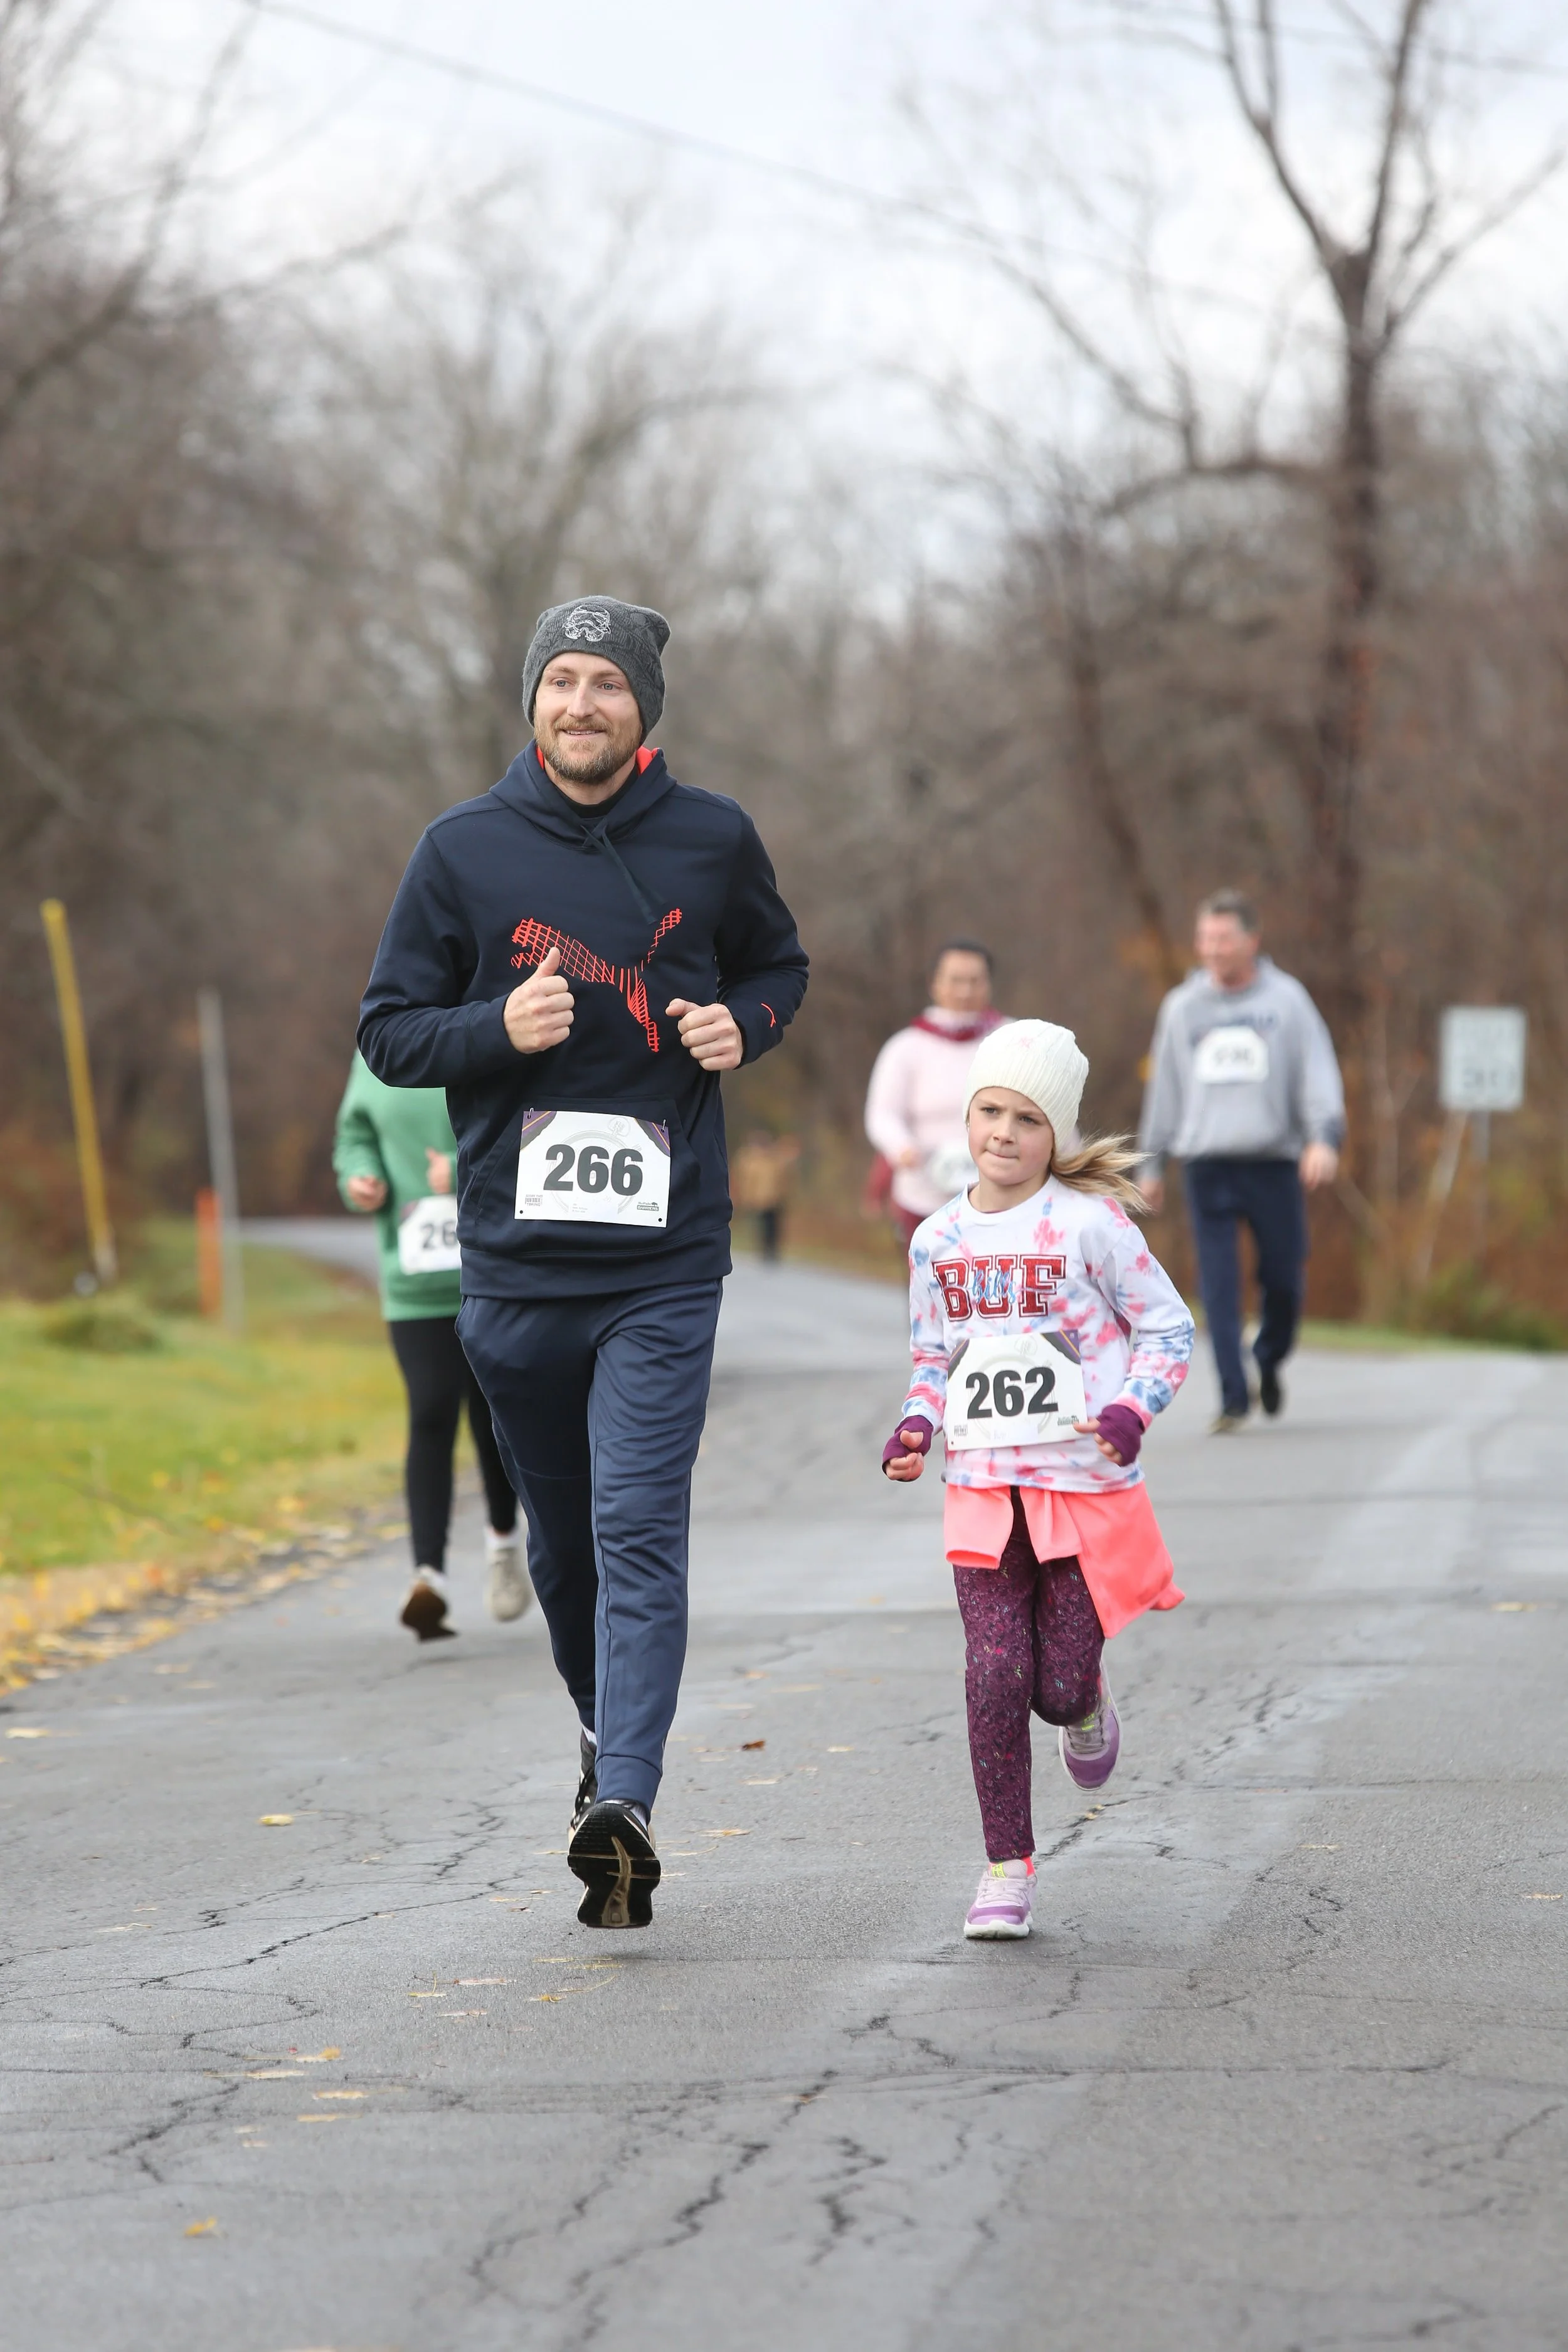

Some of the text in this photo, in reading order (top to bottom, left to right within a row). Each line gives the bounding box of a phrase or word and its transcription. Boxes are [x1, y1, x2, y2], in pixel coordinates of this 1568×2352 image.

[543, 1144, 643, 1196] 266
[931, 1254, 1066, 1322] BUF
[966, 1367, 1059, 1419] 262
